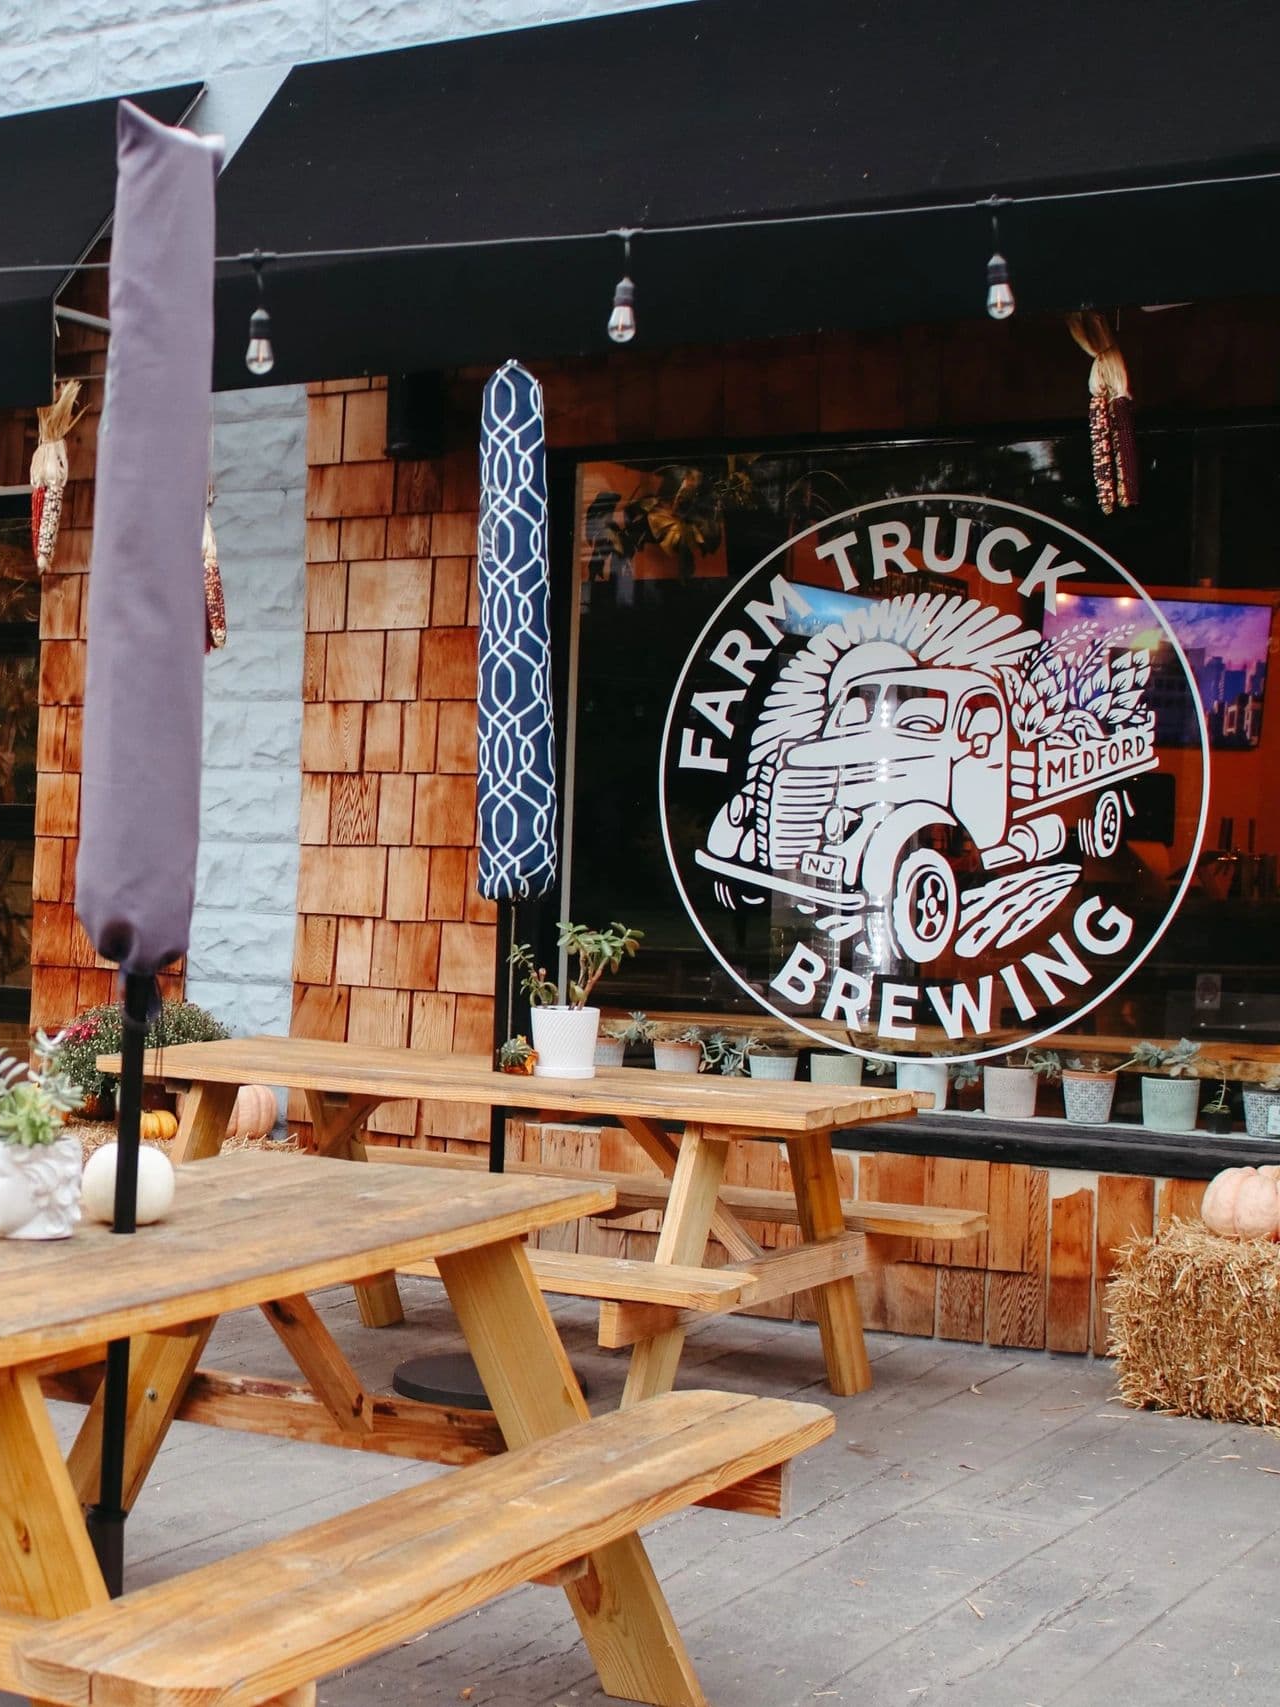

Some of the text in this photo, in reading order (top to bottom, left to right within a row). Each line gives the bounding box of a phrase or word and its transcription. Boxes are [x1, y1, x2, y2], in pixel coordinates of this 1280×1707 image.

[678, 516, 1087, 774] FARM TRUCK
[1046, 735, 1146, 788] MEDFORD
[807, 858, 835, 875] NJ
[770, 895, 1134, 1041] BREWING
